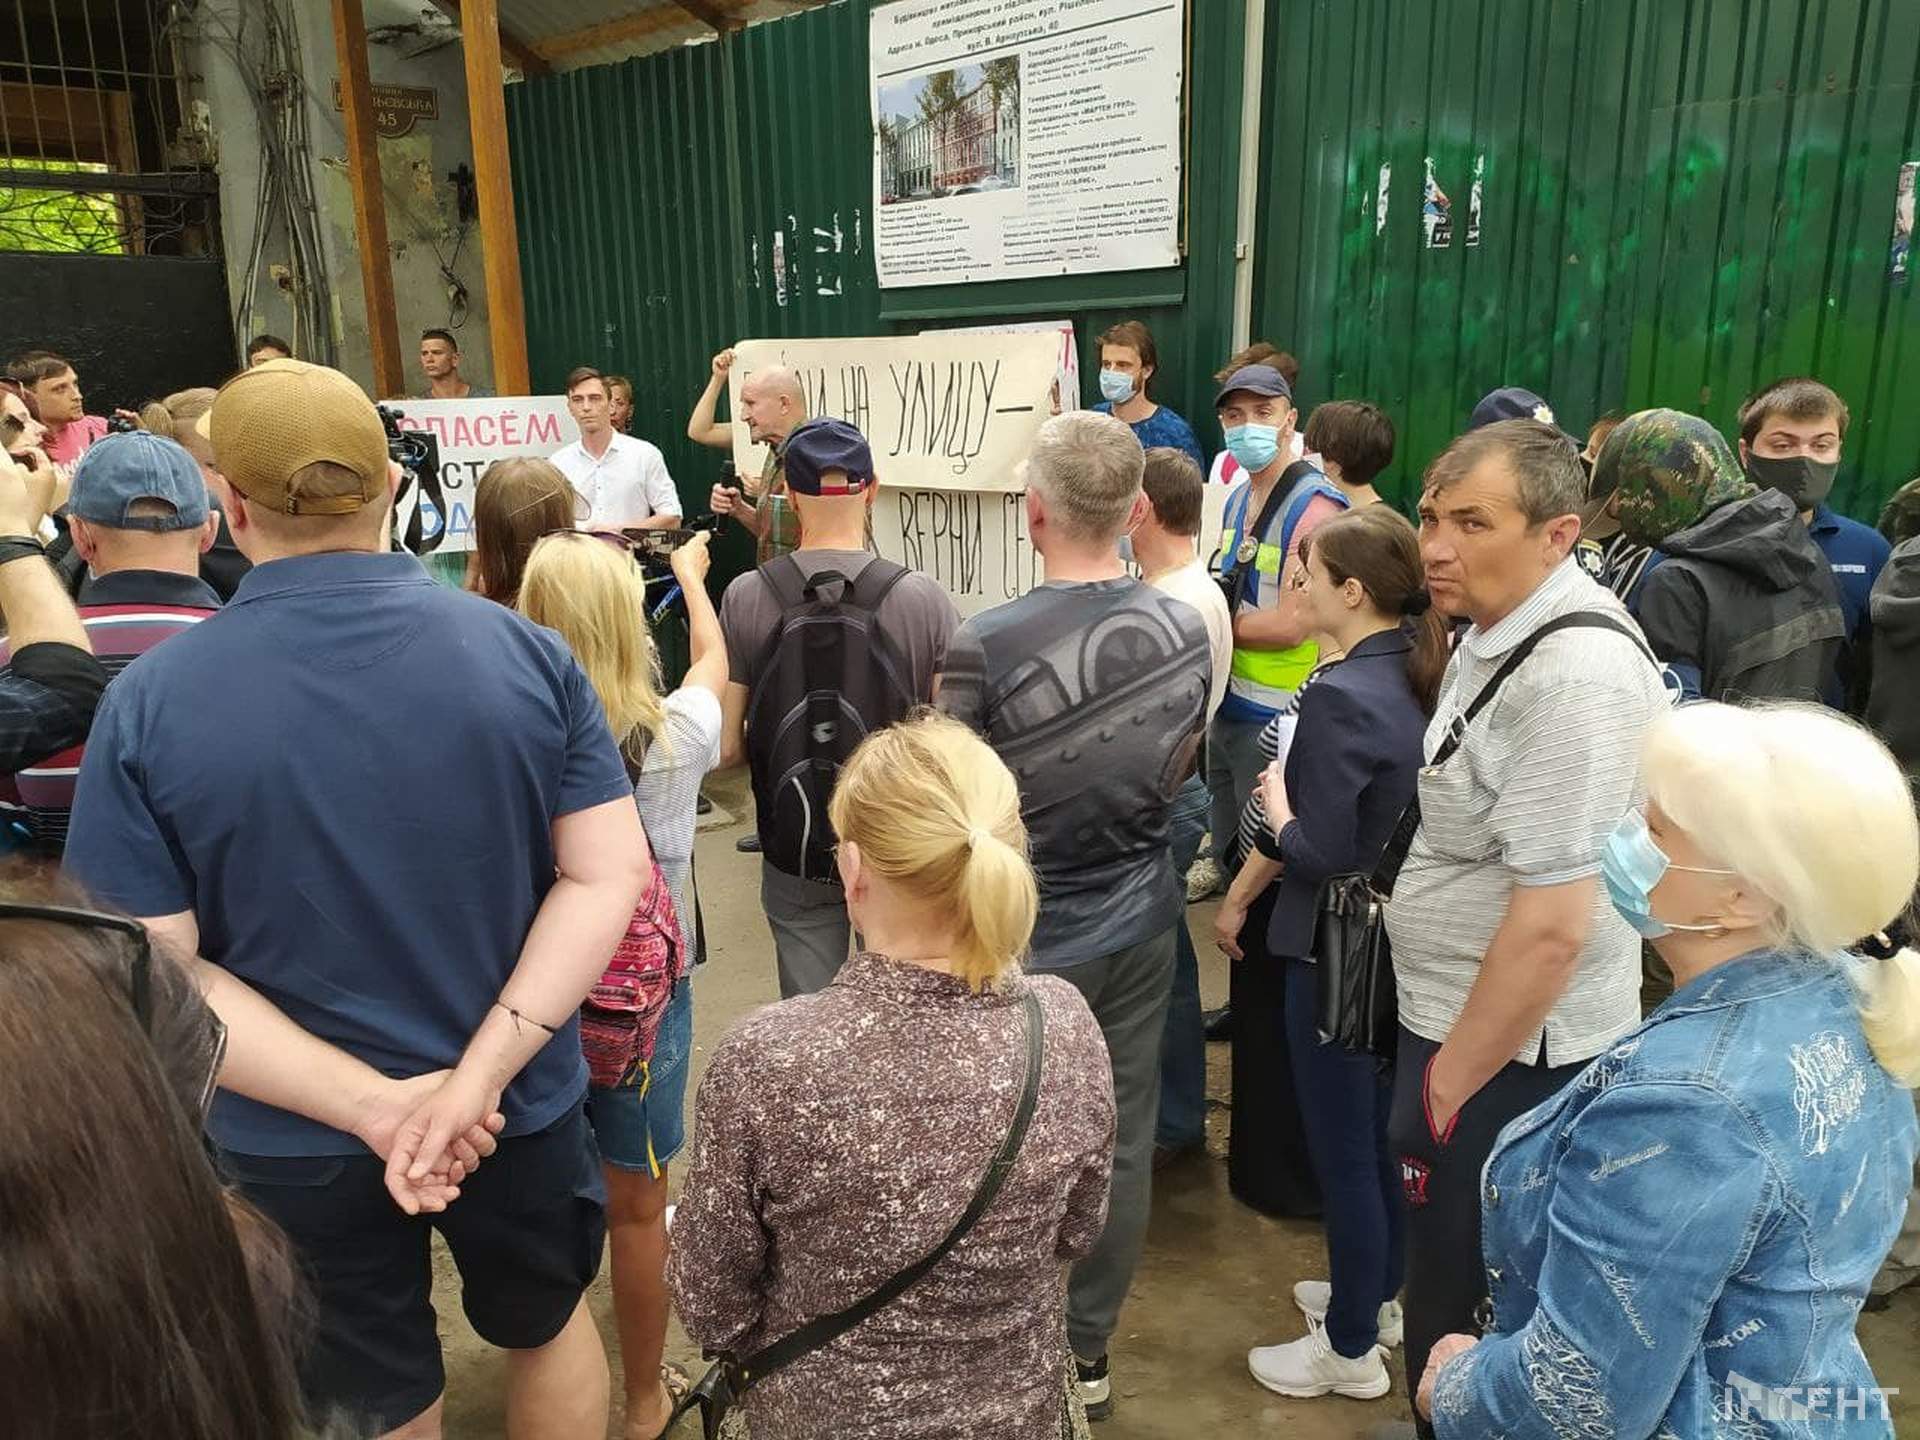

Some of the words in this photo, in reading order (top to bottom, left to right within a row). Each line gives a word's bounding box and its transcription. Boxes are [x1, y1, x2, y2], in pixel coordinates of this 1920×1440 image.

[378, 111, 397, 127] 45
[888, 358, 1000, 475] УЛИЦУ
[898, 491, 983, 596] ВЕРНИ
